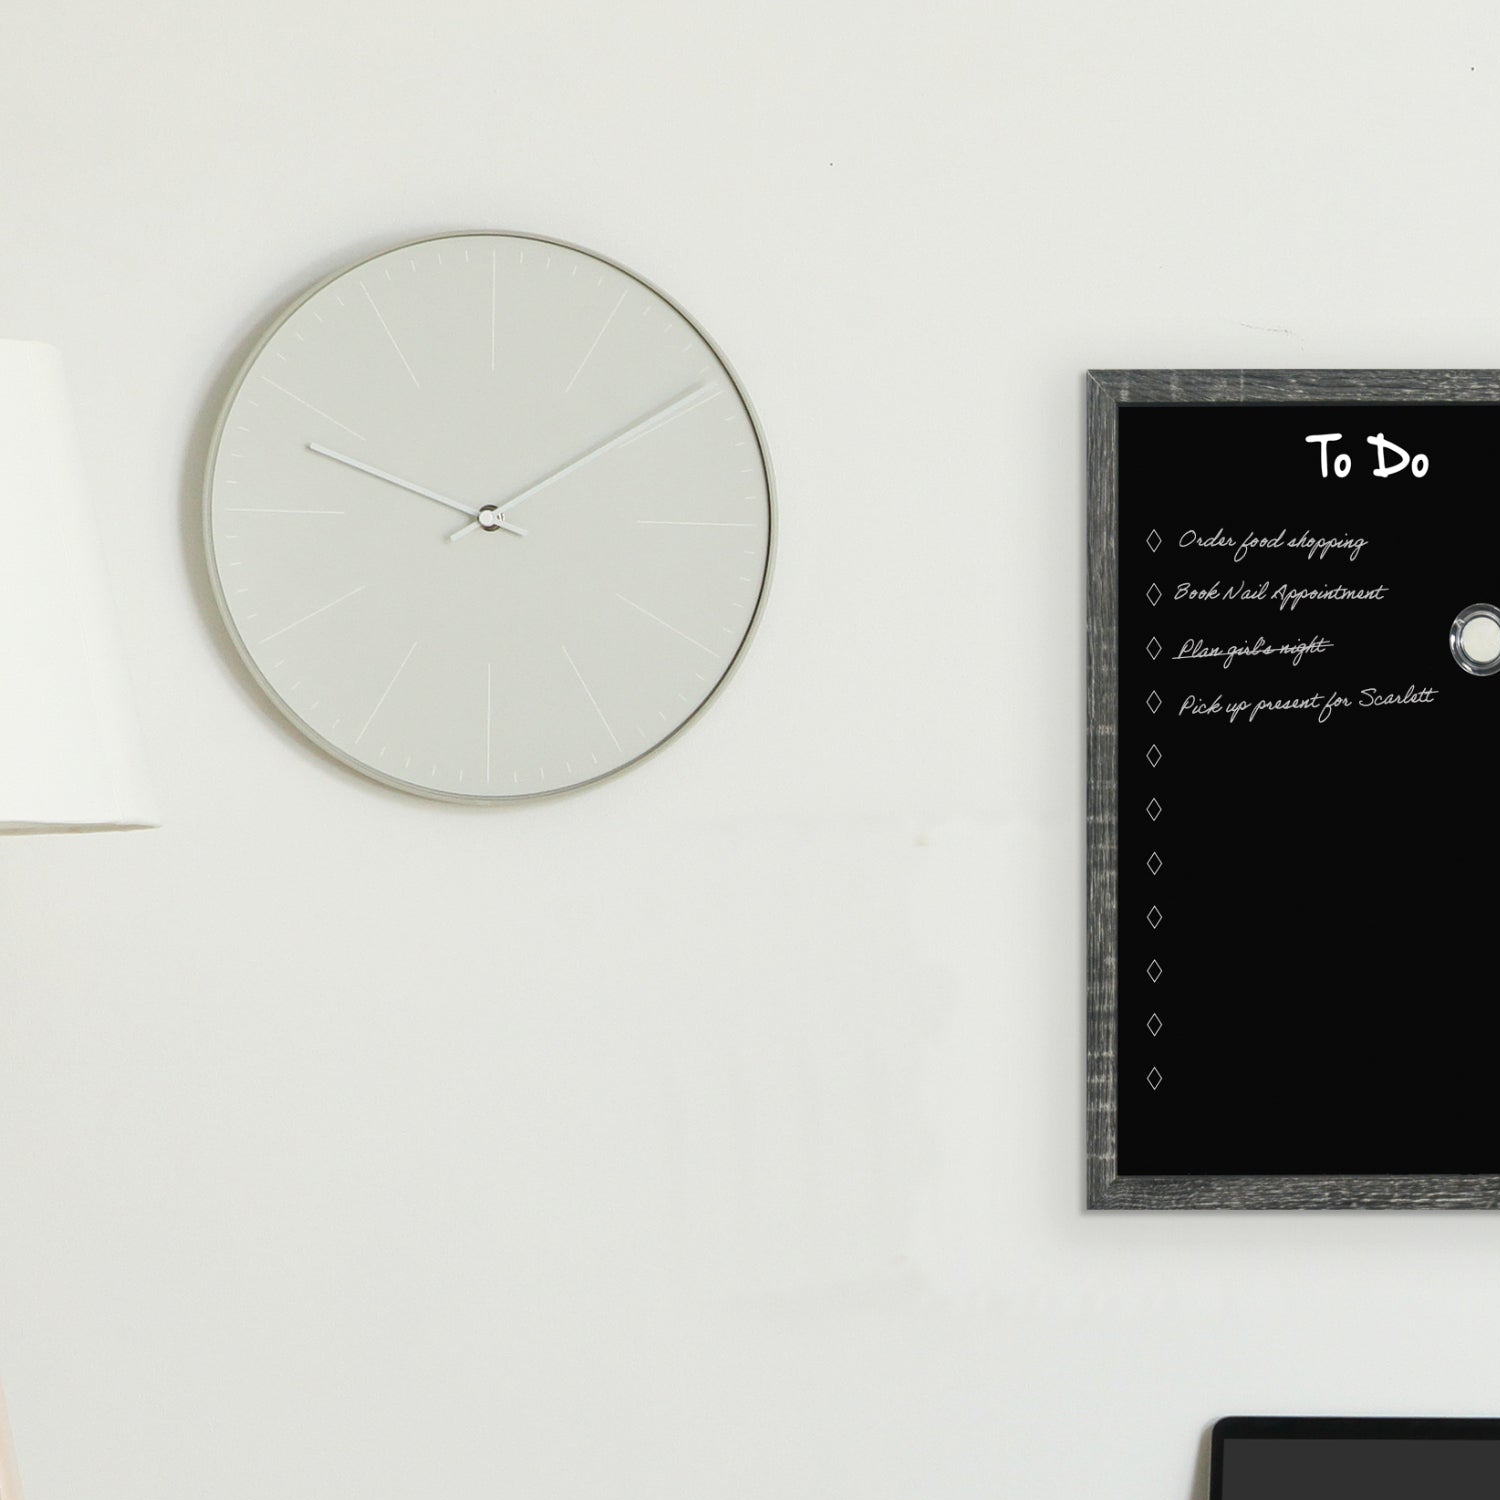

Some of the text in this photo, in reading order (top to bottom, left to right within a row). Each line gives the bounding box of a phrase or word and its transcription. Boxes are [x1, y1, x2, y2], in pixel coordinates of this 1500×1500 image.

[1305, 433, 1430, 478] To Do
[1178, 528, 1369, 563] Order food shopping
[1174, 580, 1390, 611] Book Nail Appointment
[1178, 638, 1224, 660] Plan
[1279, 635, 1332, 667] night
[1178, 684, 1440, 724] Pick up present for Scarlett
